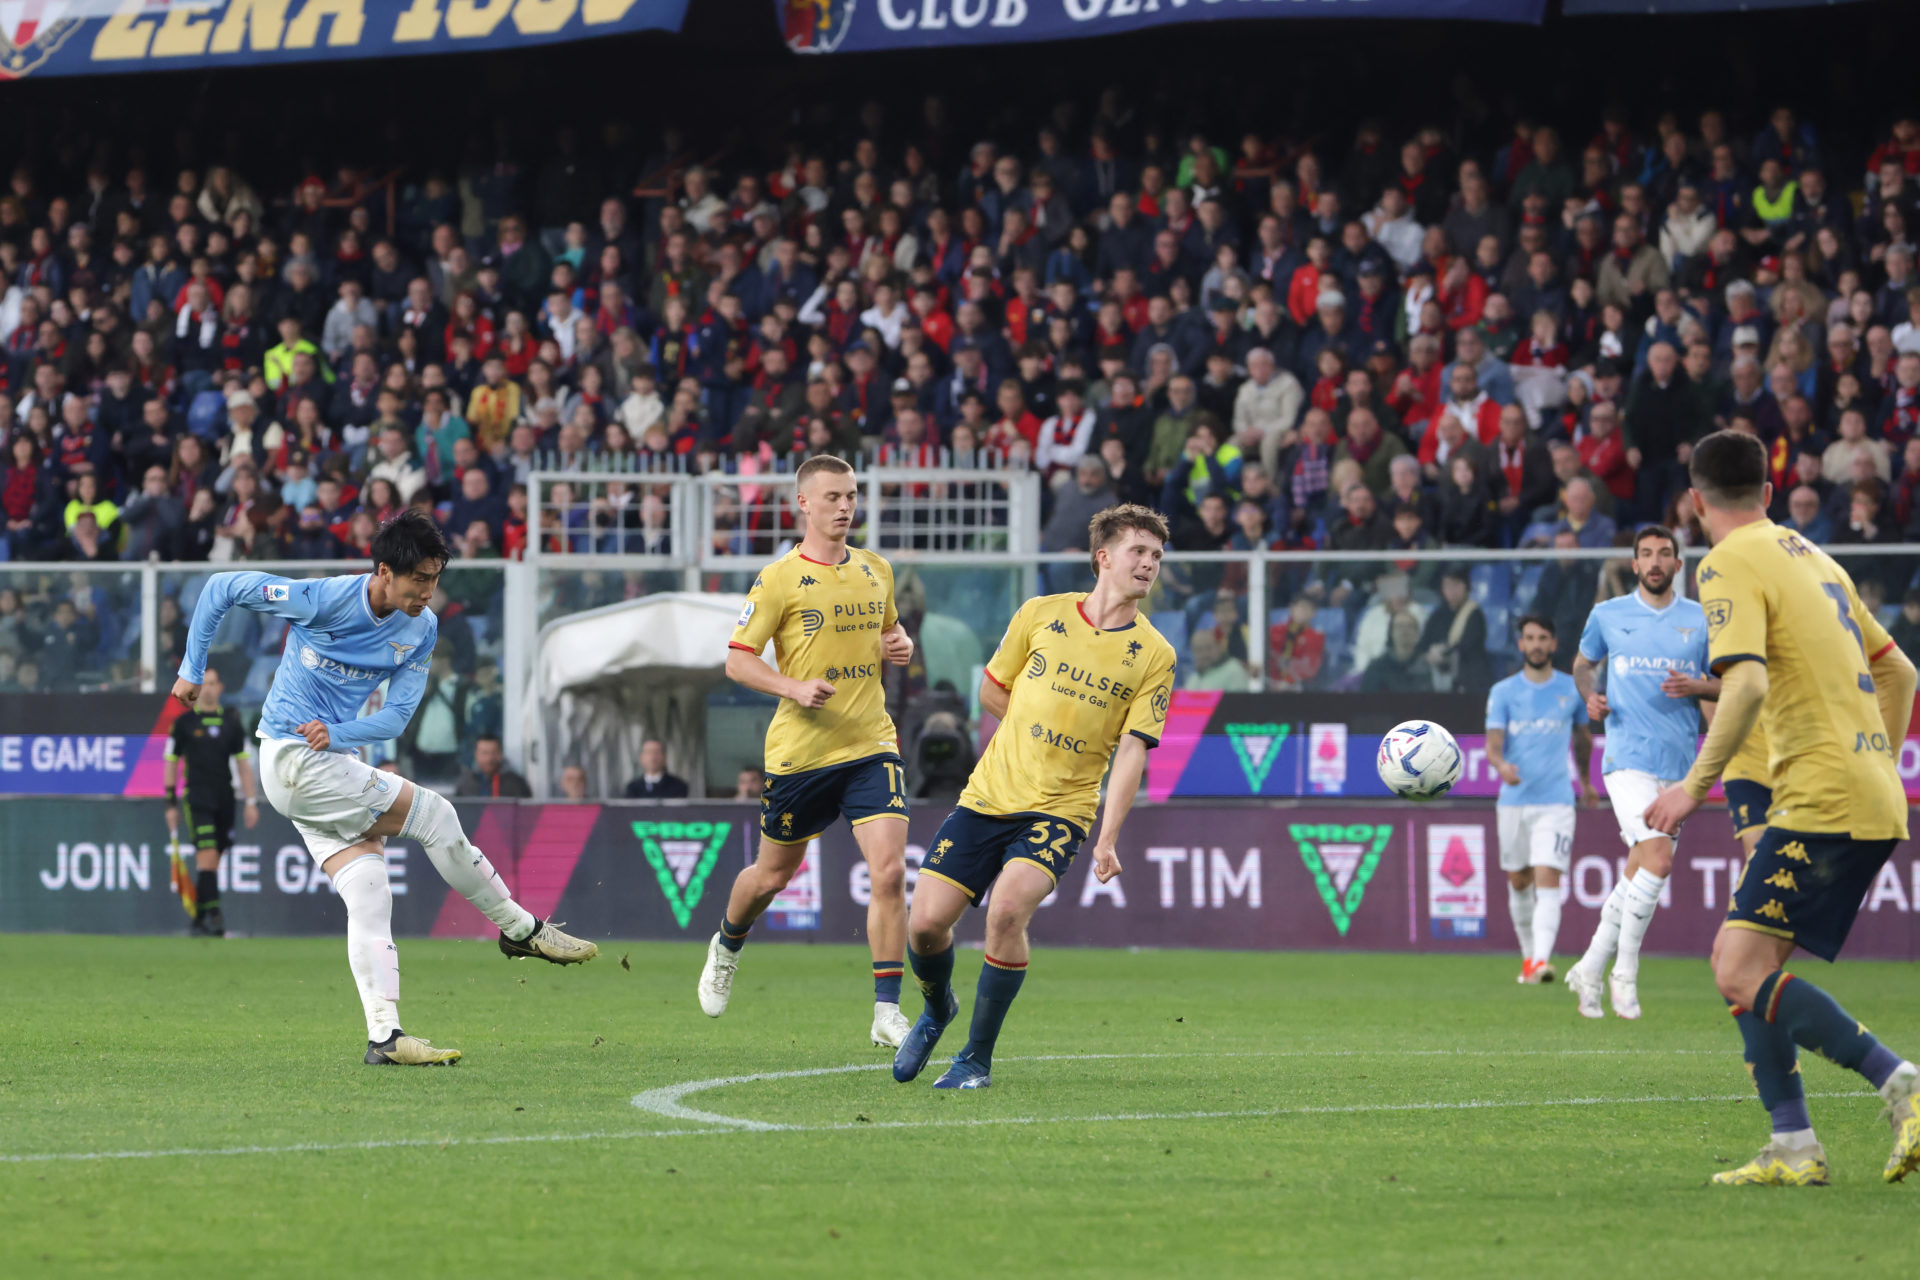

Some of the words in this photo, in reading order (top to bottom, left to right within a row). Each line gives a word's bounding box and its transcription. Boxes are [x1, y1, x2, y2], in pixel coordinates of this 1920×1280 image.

[836, 623, 856, 632] Luce
[867, 621, 880, 630] Gas
[842, 663, 876, 680] MSC
[1056, 662, 1134, 701] PULSEE
[1051, 681, 1076, 697] Luce
[1079, 692, 1086, 701] e
[1089, 695, 1108, 709] Gas
[31, 736, 126, 772] GAME
[1044, 728, 1087, 754] MSC
[1028, 821, 1072, 858] 32
[40, 843, 151, 891] JOIN
[275, 844, 408, 894] GAE
[1146, 847, 1262, 909] TIM
